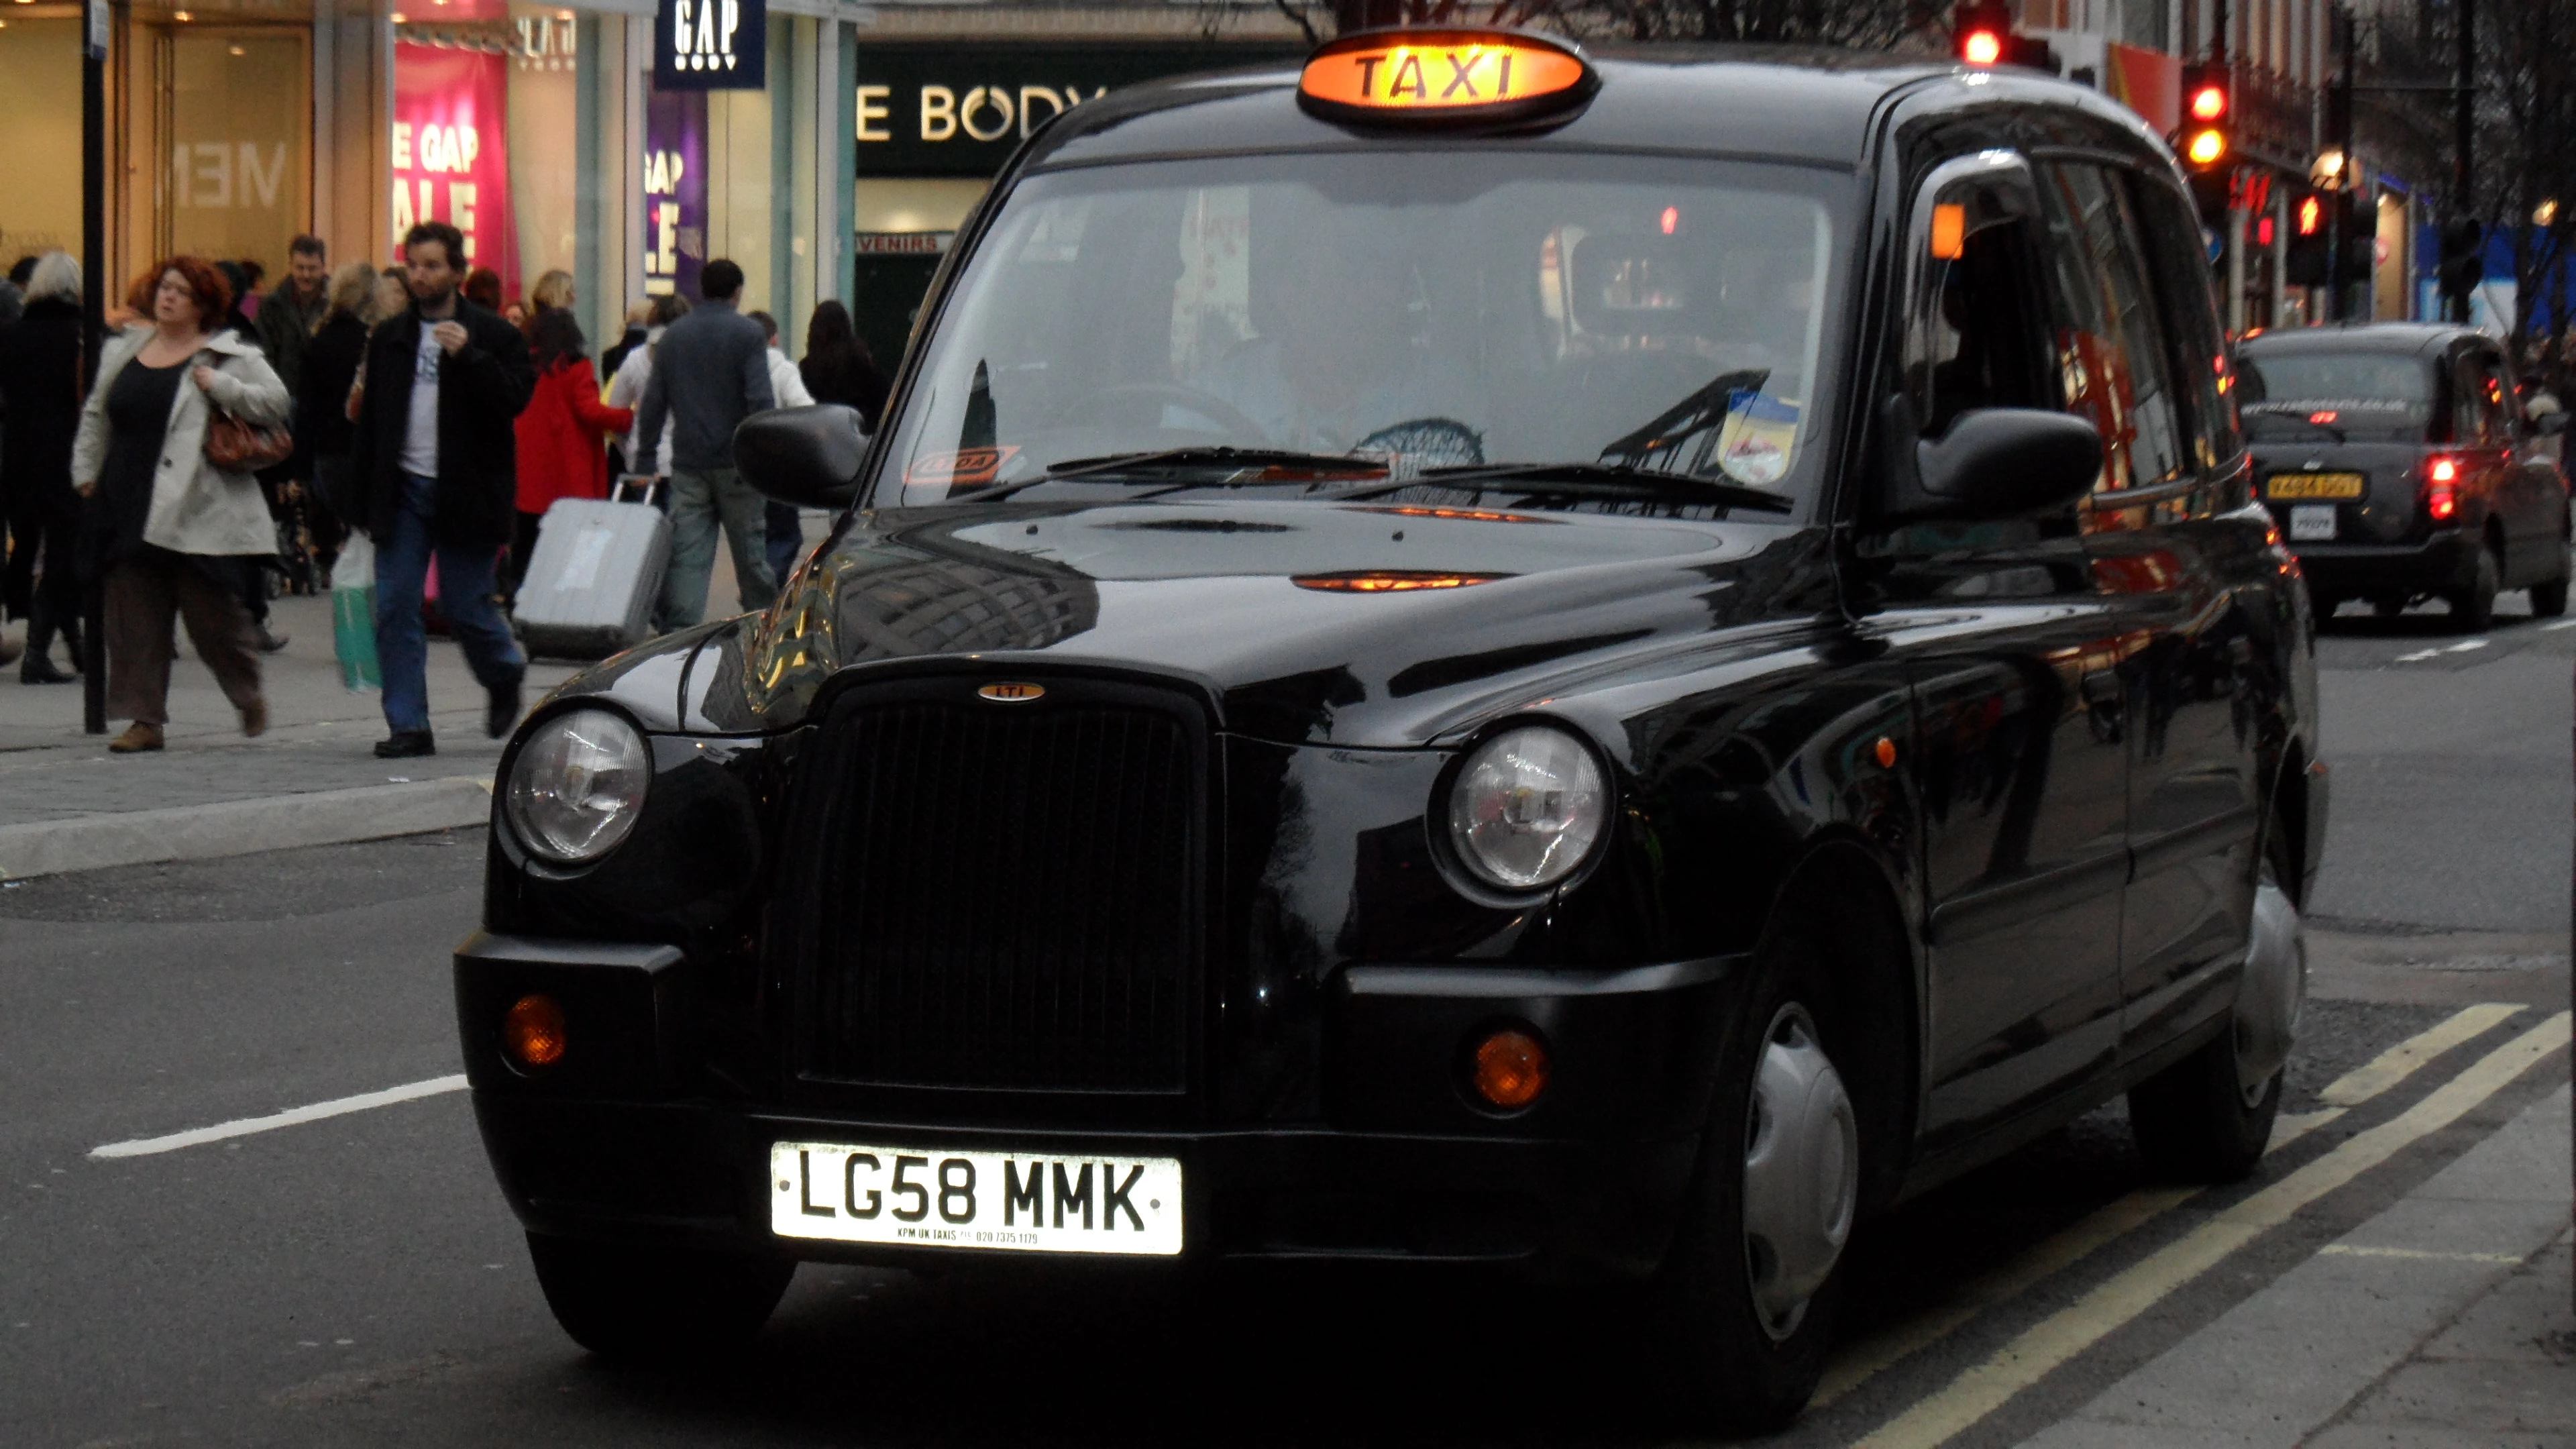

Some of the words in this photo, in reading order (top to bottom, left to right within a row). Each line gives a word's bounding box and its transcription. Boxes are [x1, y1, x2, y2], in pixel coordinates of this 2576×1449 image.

[675, 0, 739, 54] GAP
[1354, 53, 1513, 101] TAXI
[421, 123, 480, 173] GAP
[800, 1150, 976, 1225] LG58
[1004, 1159, 1145, 1232] MMK
[898, 1228, 916, 1238] KPM
[918, 1228, 930, 1240] UK
[933, 1229, 957, 1241] TAXIS
[976, 1232, 993, 1242] 020
[996, 1232, 1016, 1243] 7375
[1019, 1233, 1038, 1244] 1179
